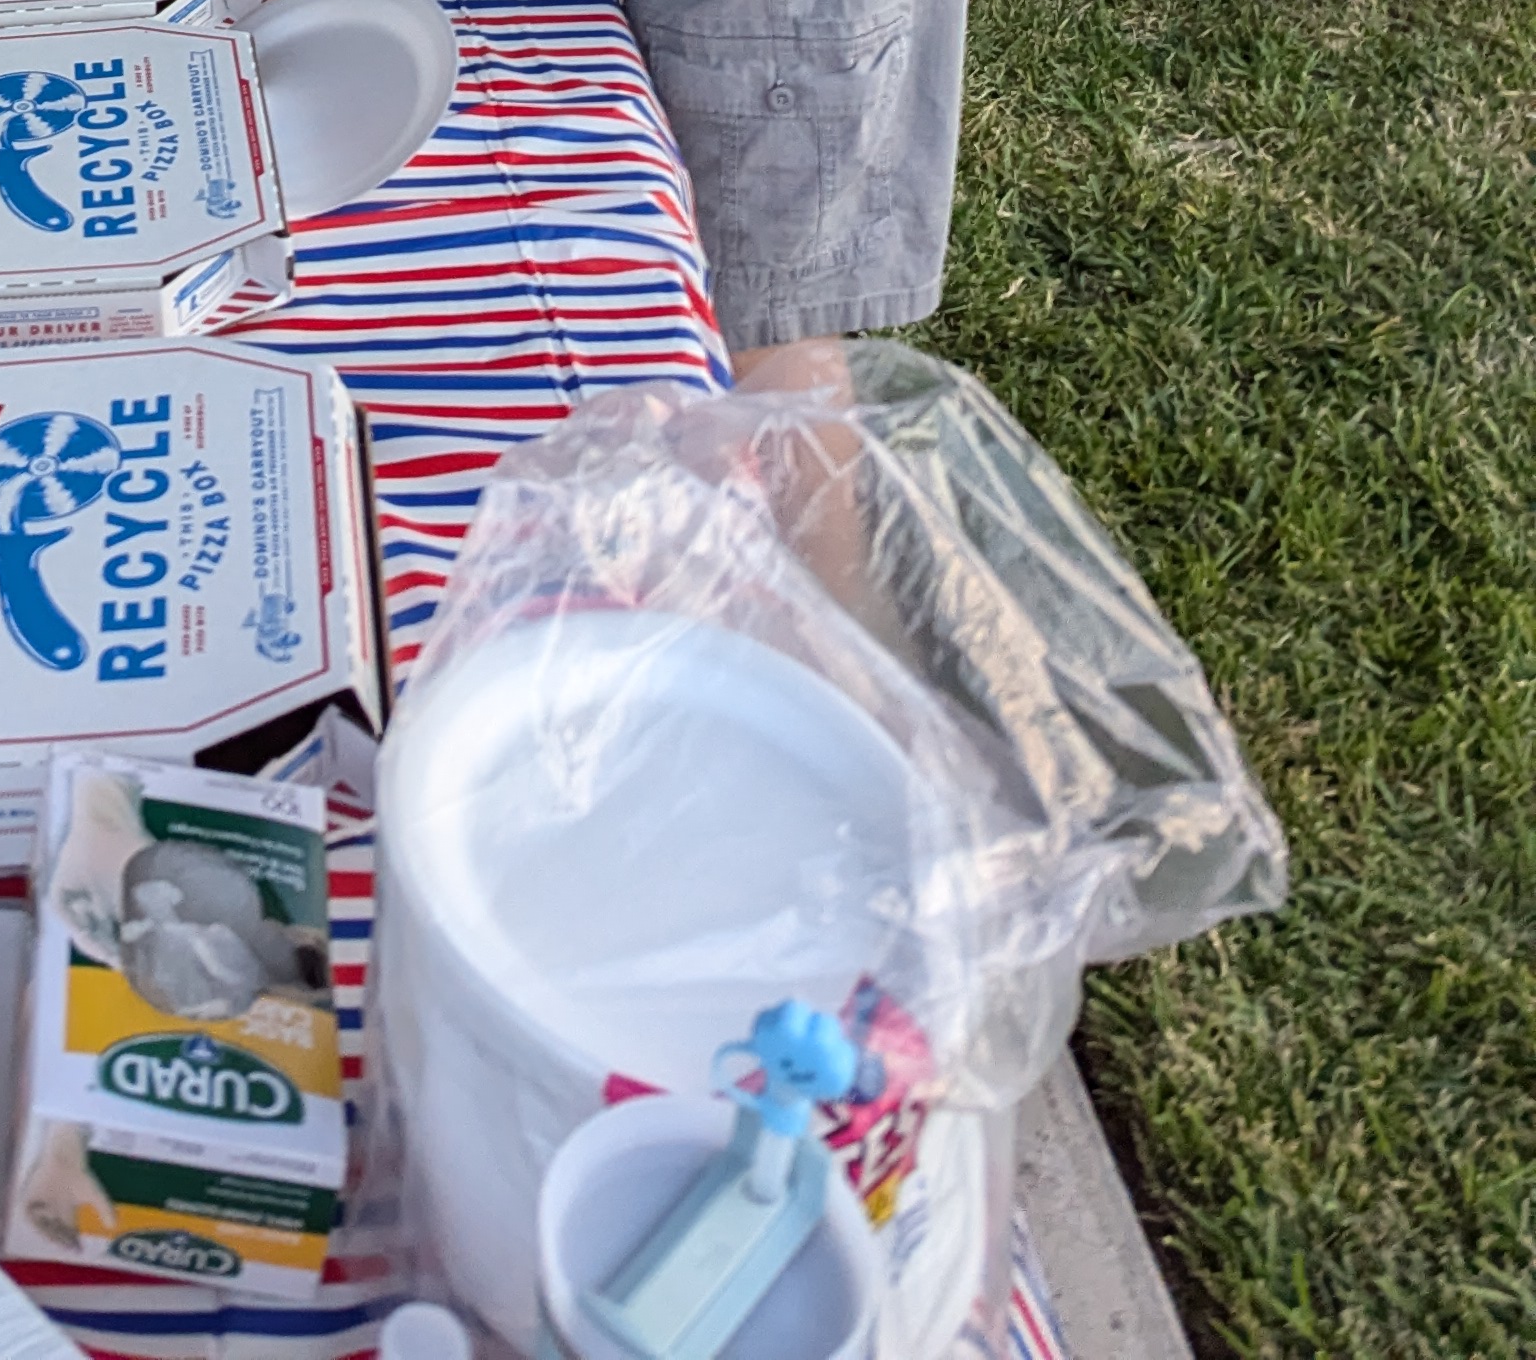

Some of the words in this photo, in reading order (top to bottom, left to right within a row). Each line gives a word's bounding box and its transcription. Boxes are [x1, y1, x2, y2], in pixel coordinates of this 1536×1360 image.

[135, 100, 174, 130] BOX
[187, 63, 205, 118] CARRYOUT
[74, 58, 138, 238] RECYCLE
[137, 127, 150, 156] THIS
[140, 133, 179, 182] PIZZA
[195, 120, 213, 172] DOMINO'S
[29, 322, 102, 335] DRIVER
[249, 407, 265, 491] CARRYOUT
[180, 460, 227, 508] BOX
[97, 394, 172, 684] RECYCLE
[179, 503, 194, 547] THIS
[251, 497, 269, 579] DOMINO'S
[177, 514, 231, 591] PIZZA
[112, 1052, 291, 1118] CURAD
[119, 1236, 235, 1276] CURAD
